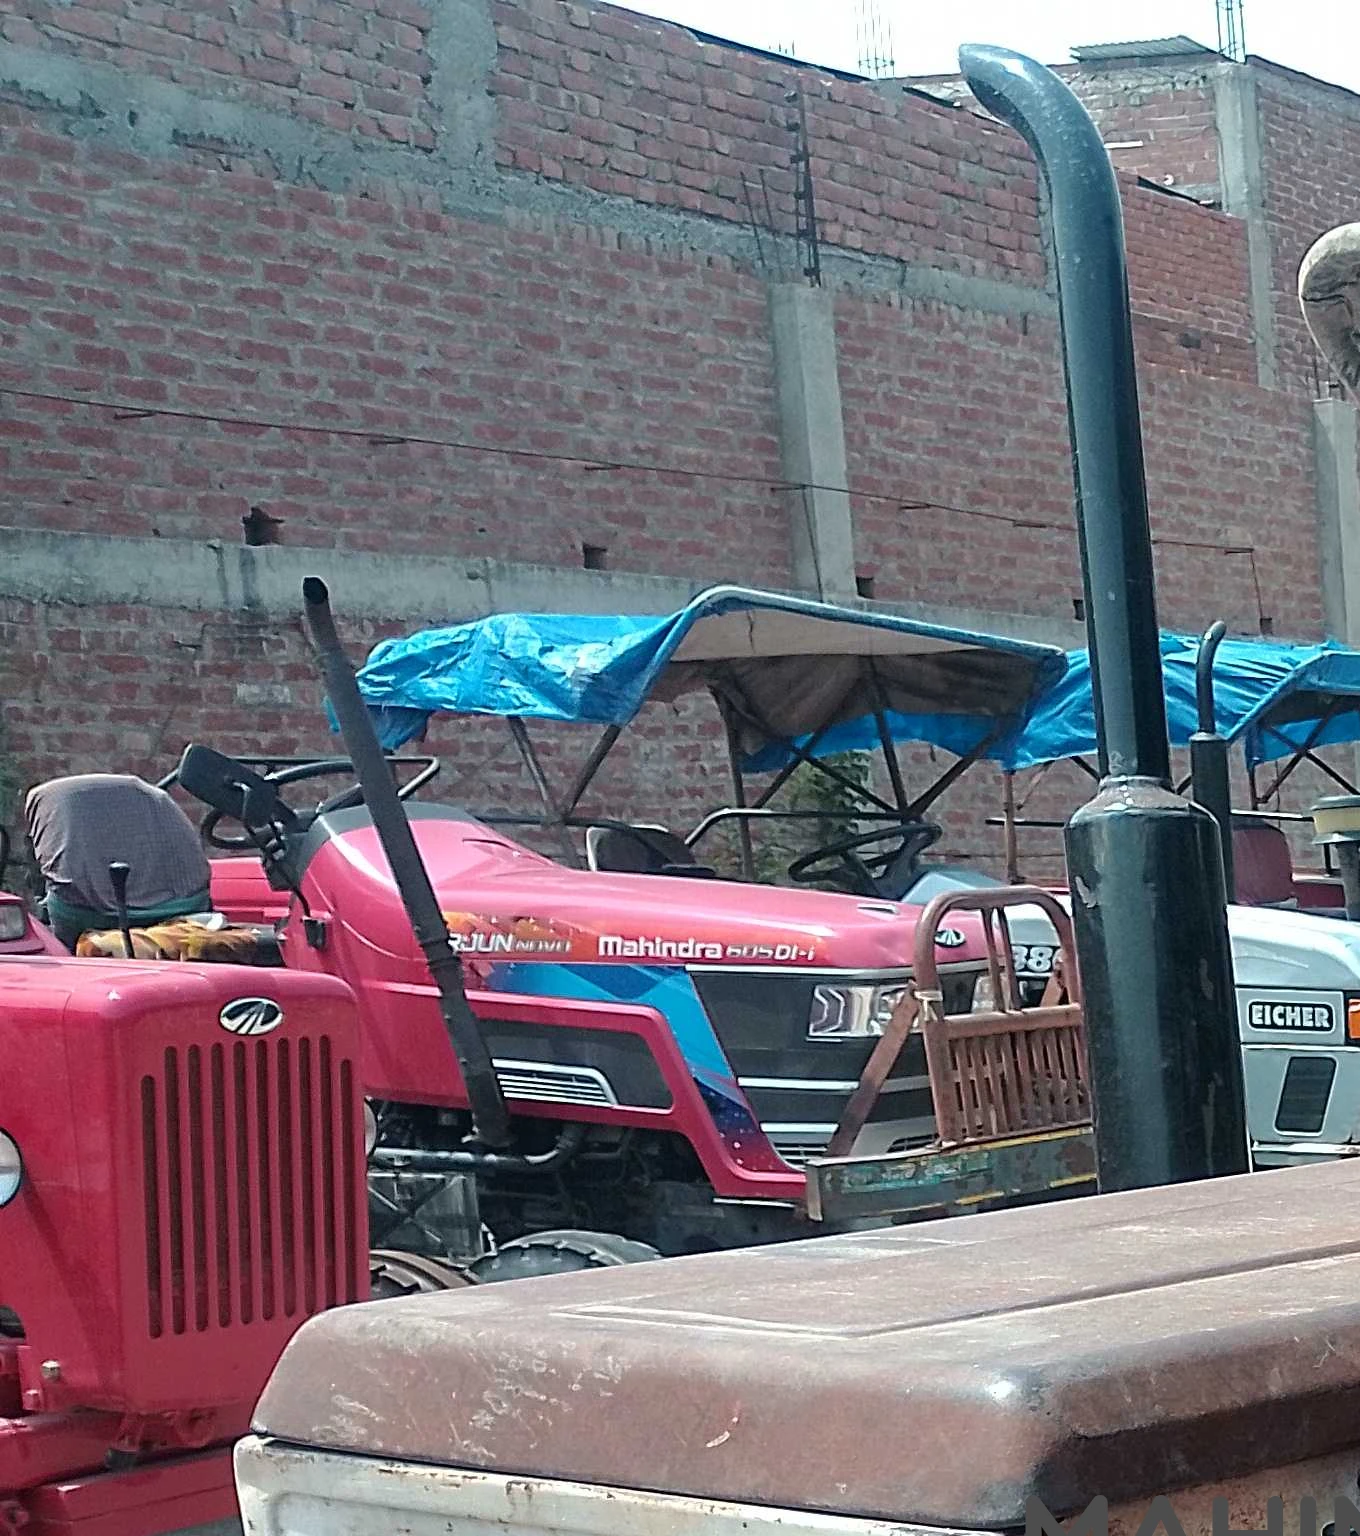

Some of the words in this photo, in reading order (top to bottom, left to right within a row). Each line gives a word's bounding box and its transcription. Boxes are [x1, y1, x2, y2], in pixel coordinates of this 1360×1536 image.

[448, 932, 513, 953] RJUN
[598, 935, 724, 960] Mahindra
[1251, 1004, 1331, 1028] EICHER
